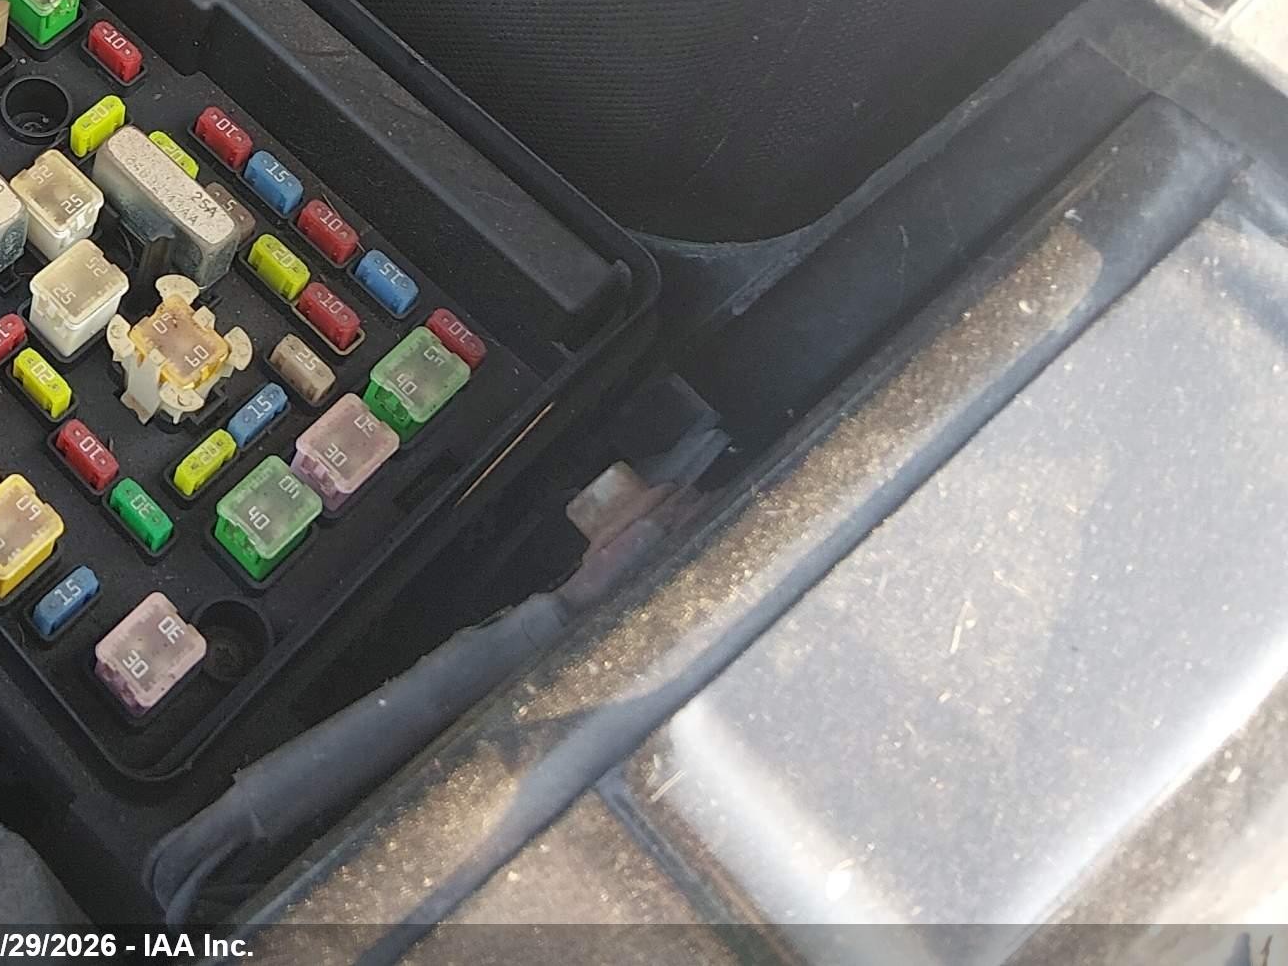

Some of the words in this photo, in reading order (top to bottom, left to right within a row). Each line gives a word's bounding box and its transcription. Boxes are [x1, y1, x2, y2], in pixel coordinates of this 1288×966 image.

[103, 31, 128, 51] 10
[90, 105, 110, 124] 20
[215, 118, 239, 138] 10
[31, 164, 54, 185] 25
[265, 161, 290, 183] 15
[60, 193, 84, 215] 25
[192, 191, 217, 217] 25A
[222, 199, 238, 212] 5
[319, 210, 344, 232] 10
[85, 256, 108, 277] 25
[271, 247, 297, 269] 20
[378, 262, 406, 285] 15
[52, 286, 77, 305] 25
[319, 292, 344, 314] 10
[449, 321, 473, 344] 10
[184, 345, 209, 367] 60
[295, 347, 318, 371] 25
[30, 360, 54, 384] 20
[396, 373, 418, 395] 40
[246, 395, 273, 420] 15
[79, 435, 105, 461] 10
[324, 443, 348, 467] 30
[278, 474, 300, 500] 40
[15, 494, 42, 521] 60
[130, 493, 156, 519] 30
[248, 505, 271, 531] 40
[54, 579, 82, 606] 15
[158, 616, 185, 644] 30
[122, 649, 149, 679] 30
